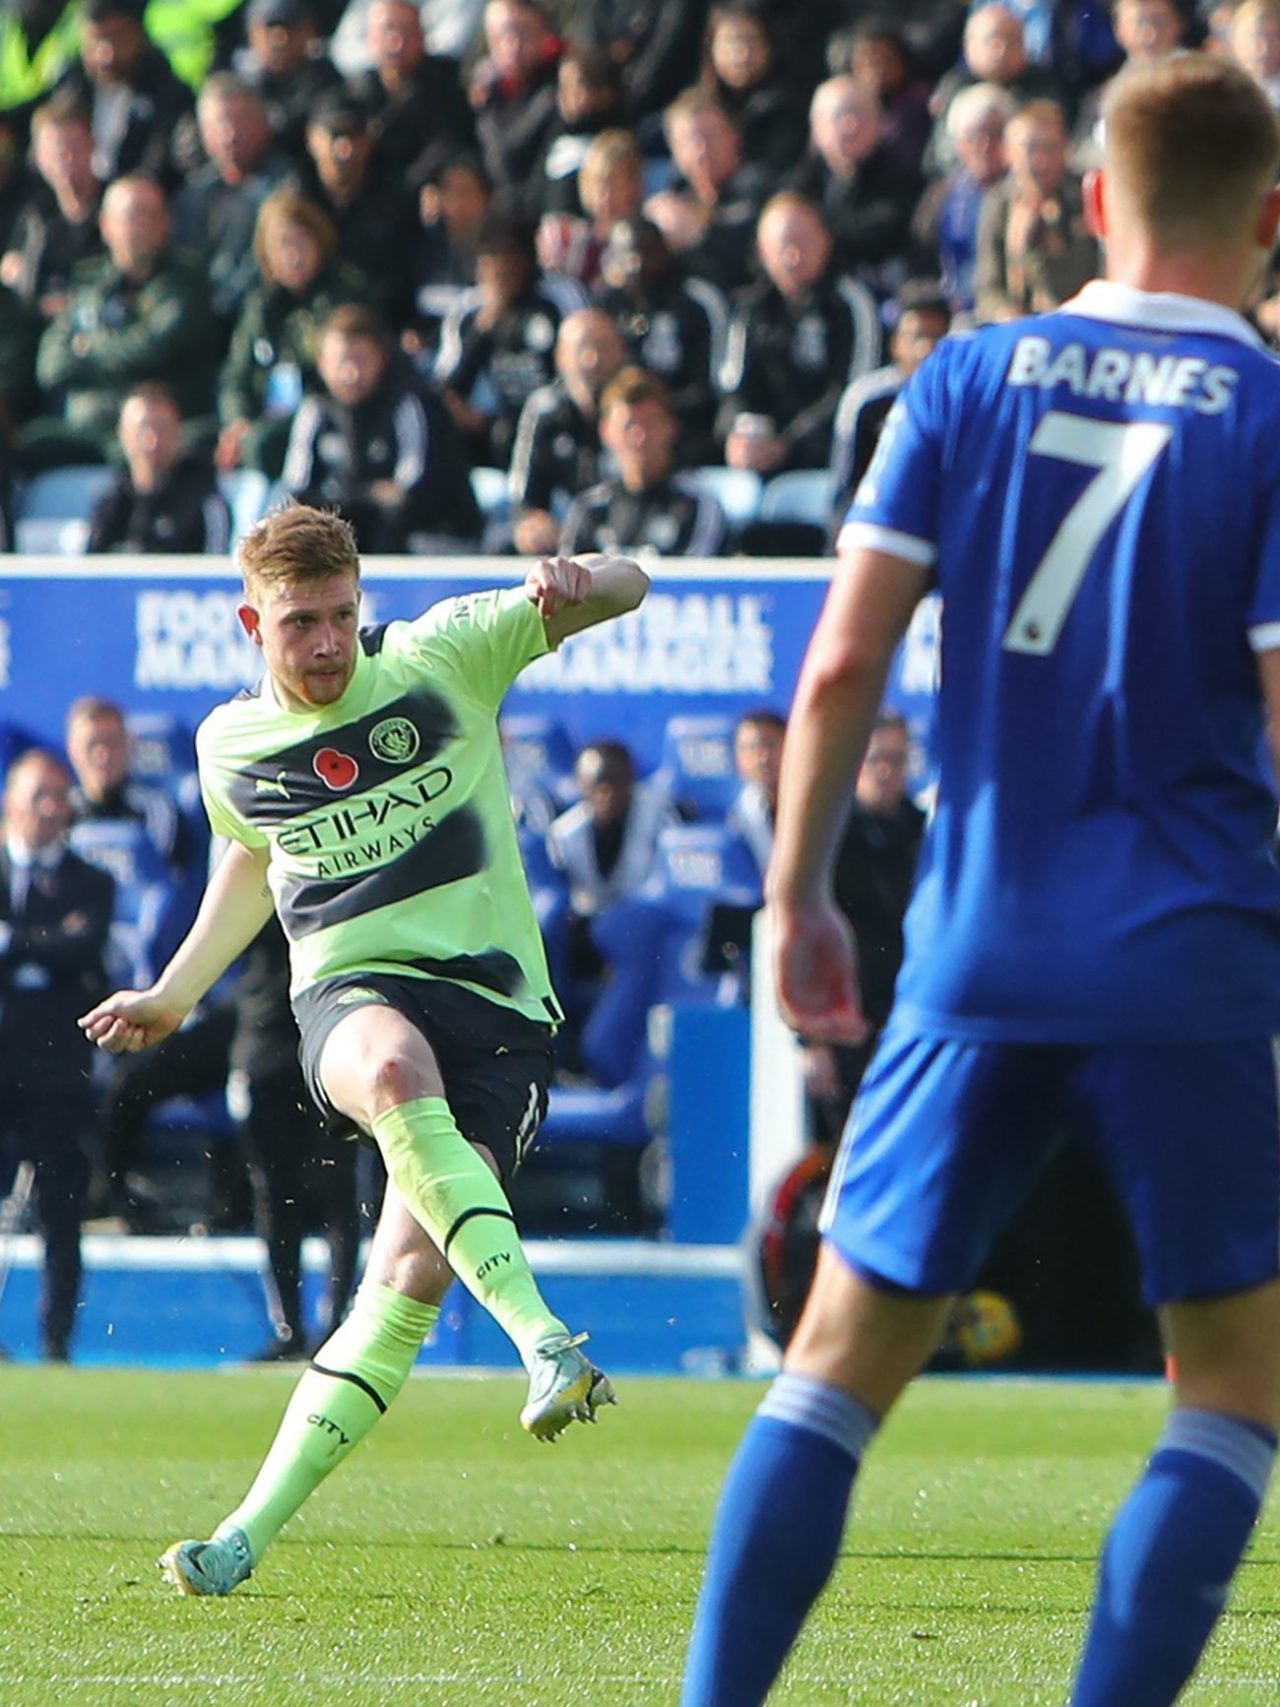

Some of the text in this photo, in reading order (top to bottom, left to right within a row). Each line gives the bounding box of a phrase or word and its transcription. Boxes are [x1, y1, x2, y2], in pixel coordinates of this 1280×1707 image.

[1006, 336, 1240, 415] BARNES
[1002, 410, 1174, 657] 7
[277, 766, 453, 855] ETIHAD
[316, 815, 438, 879] AIRWAYS
[475, 1251, 511, 1281] CITY
[306, 1413, 350, 1446] CITY
